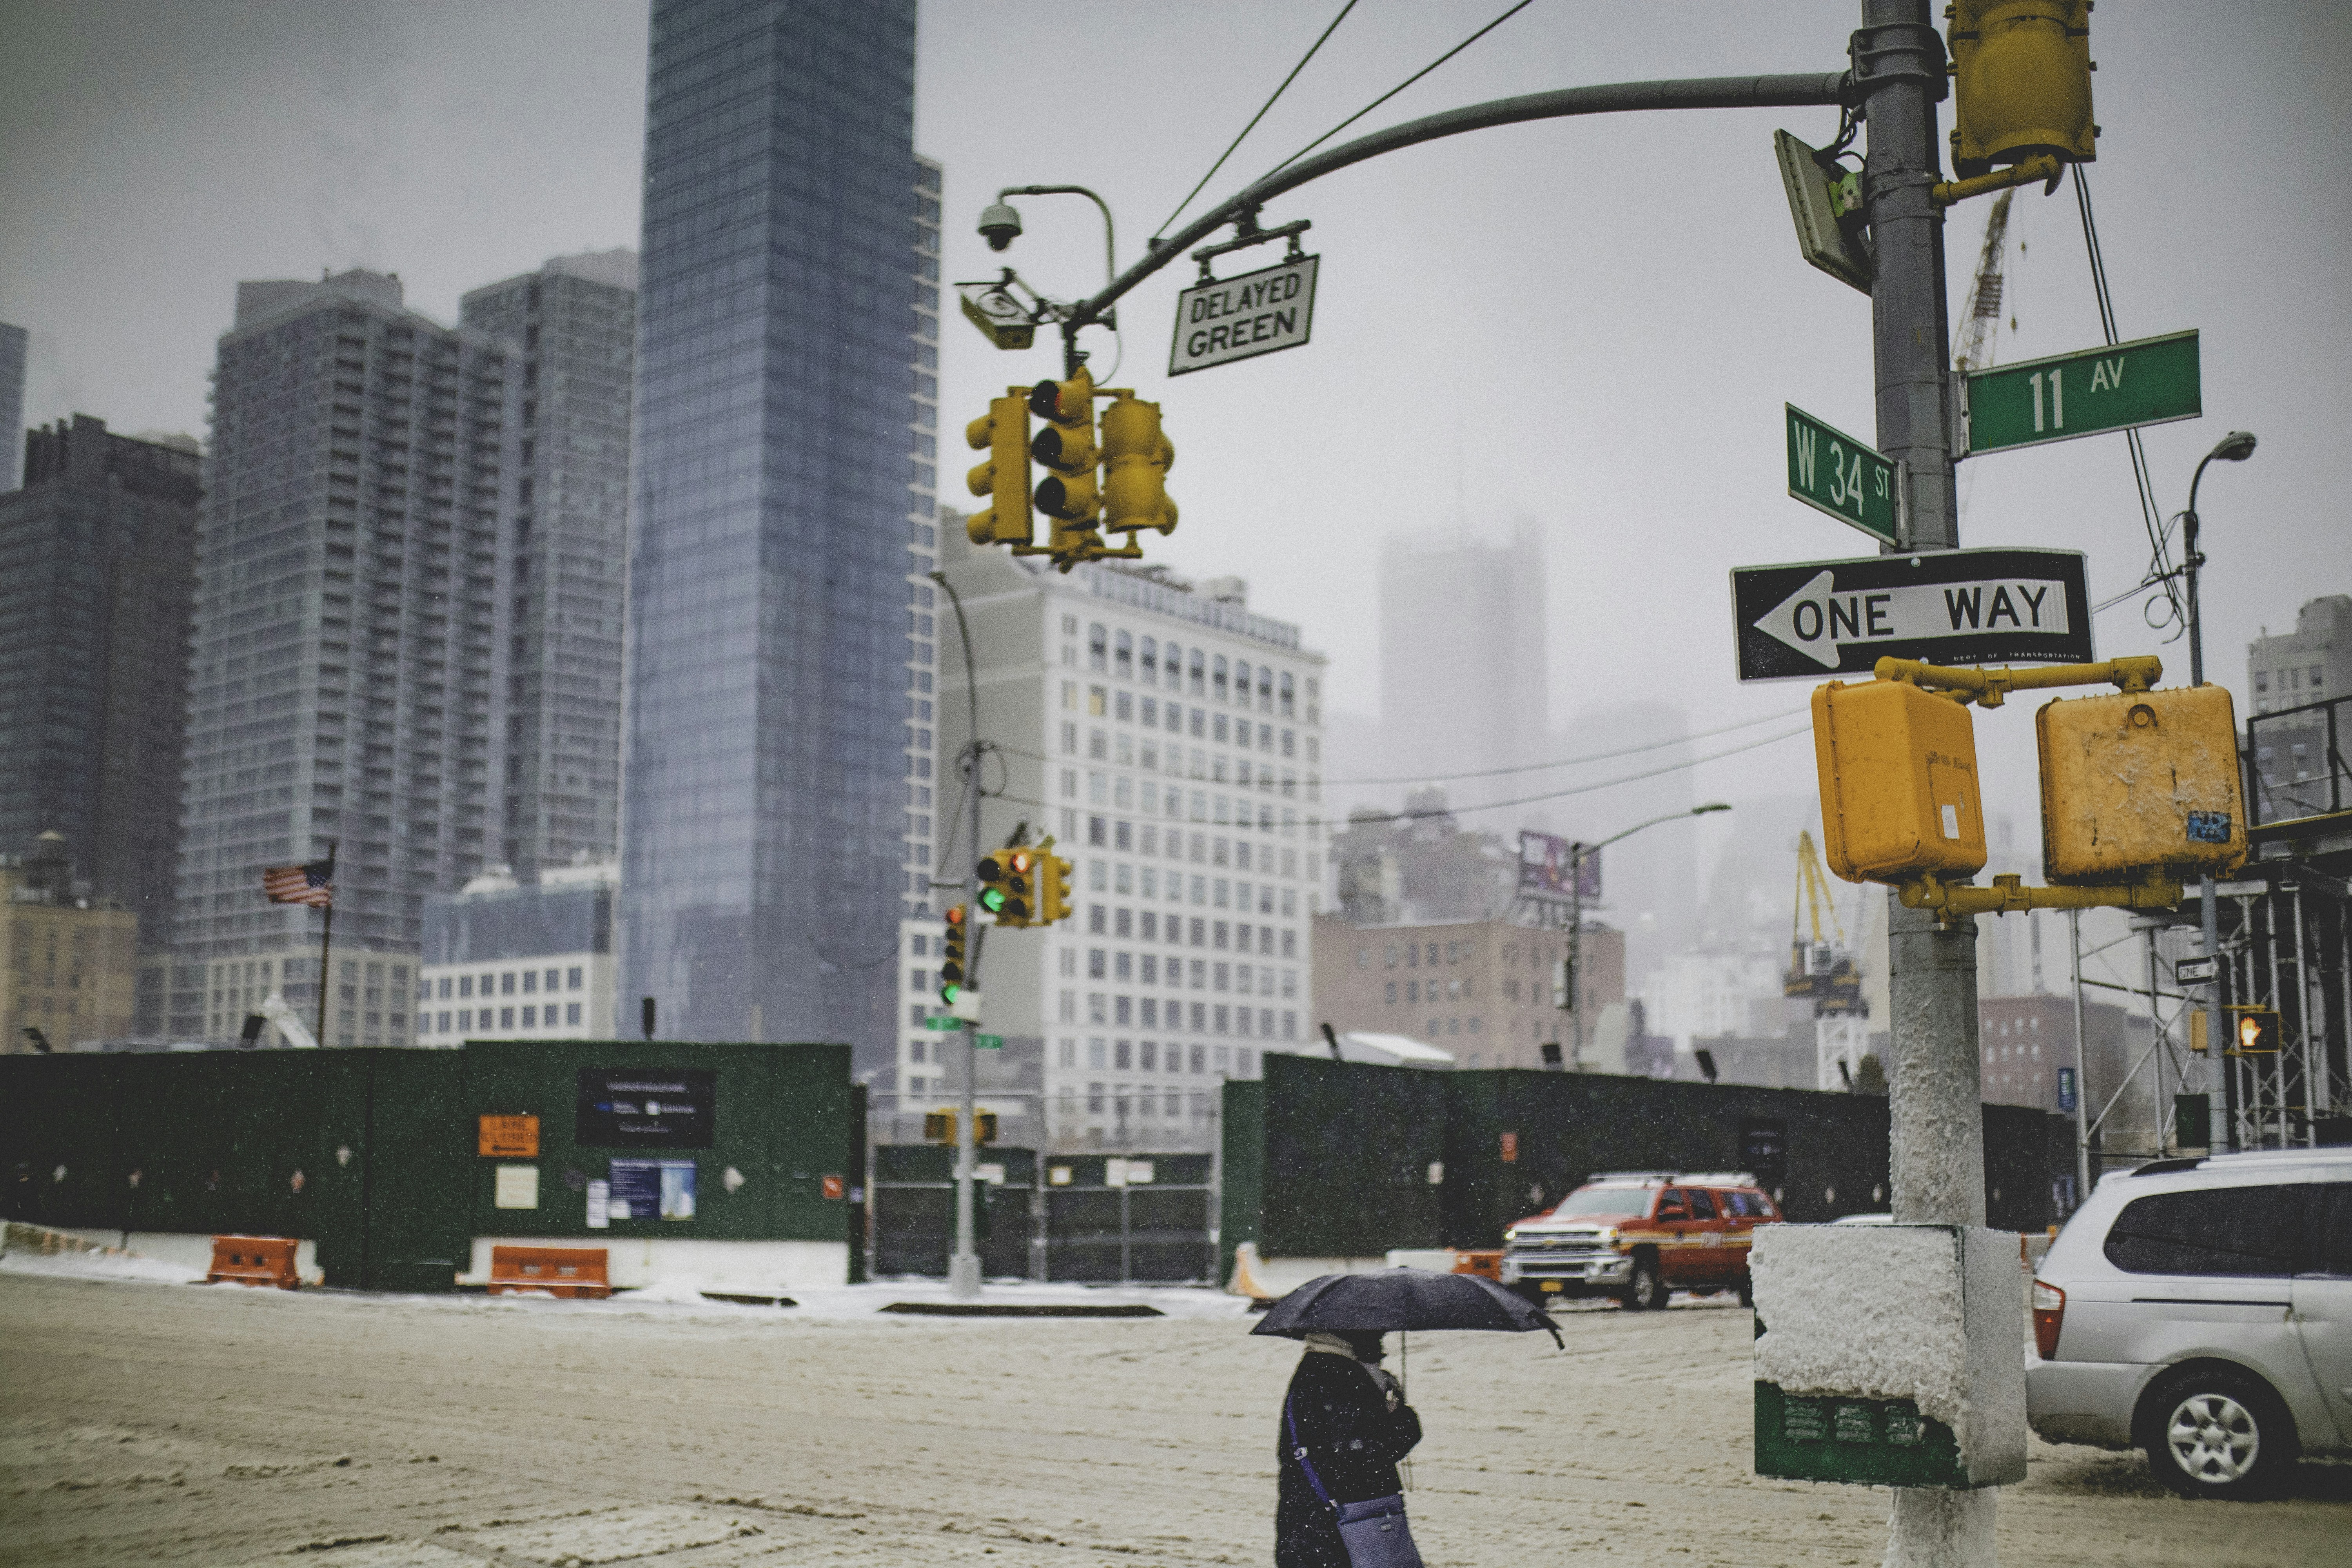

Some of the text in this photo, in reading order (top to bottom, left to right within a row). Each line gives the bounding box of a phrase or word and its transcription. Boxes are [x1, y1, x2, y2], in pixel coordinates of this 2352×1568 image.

[1190, 273, 1300, 323] DELAYED
[1187, 307, 1296, 357] GREEN
[2029, 356, 2125, 433] 11 AV
[1795, 420, 1889, 517] W 34 ST
[1793, 585, 2047, 642] ONE WAY
[1954, 653, 1976, 662] DEPT
[2009, 651, 2080, 659] TRANSPORTATION
[2180, 965, 2199, 978] ONE
